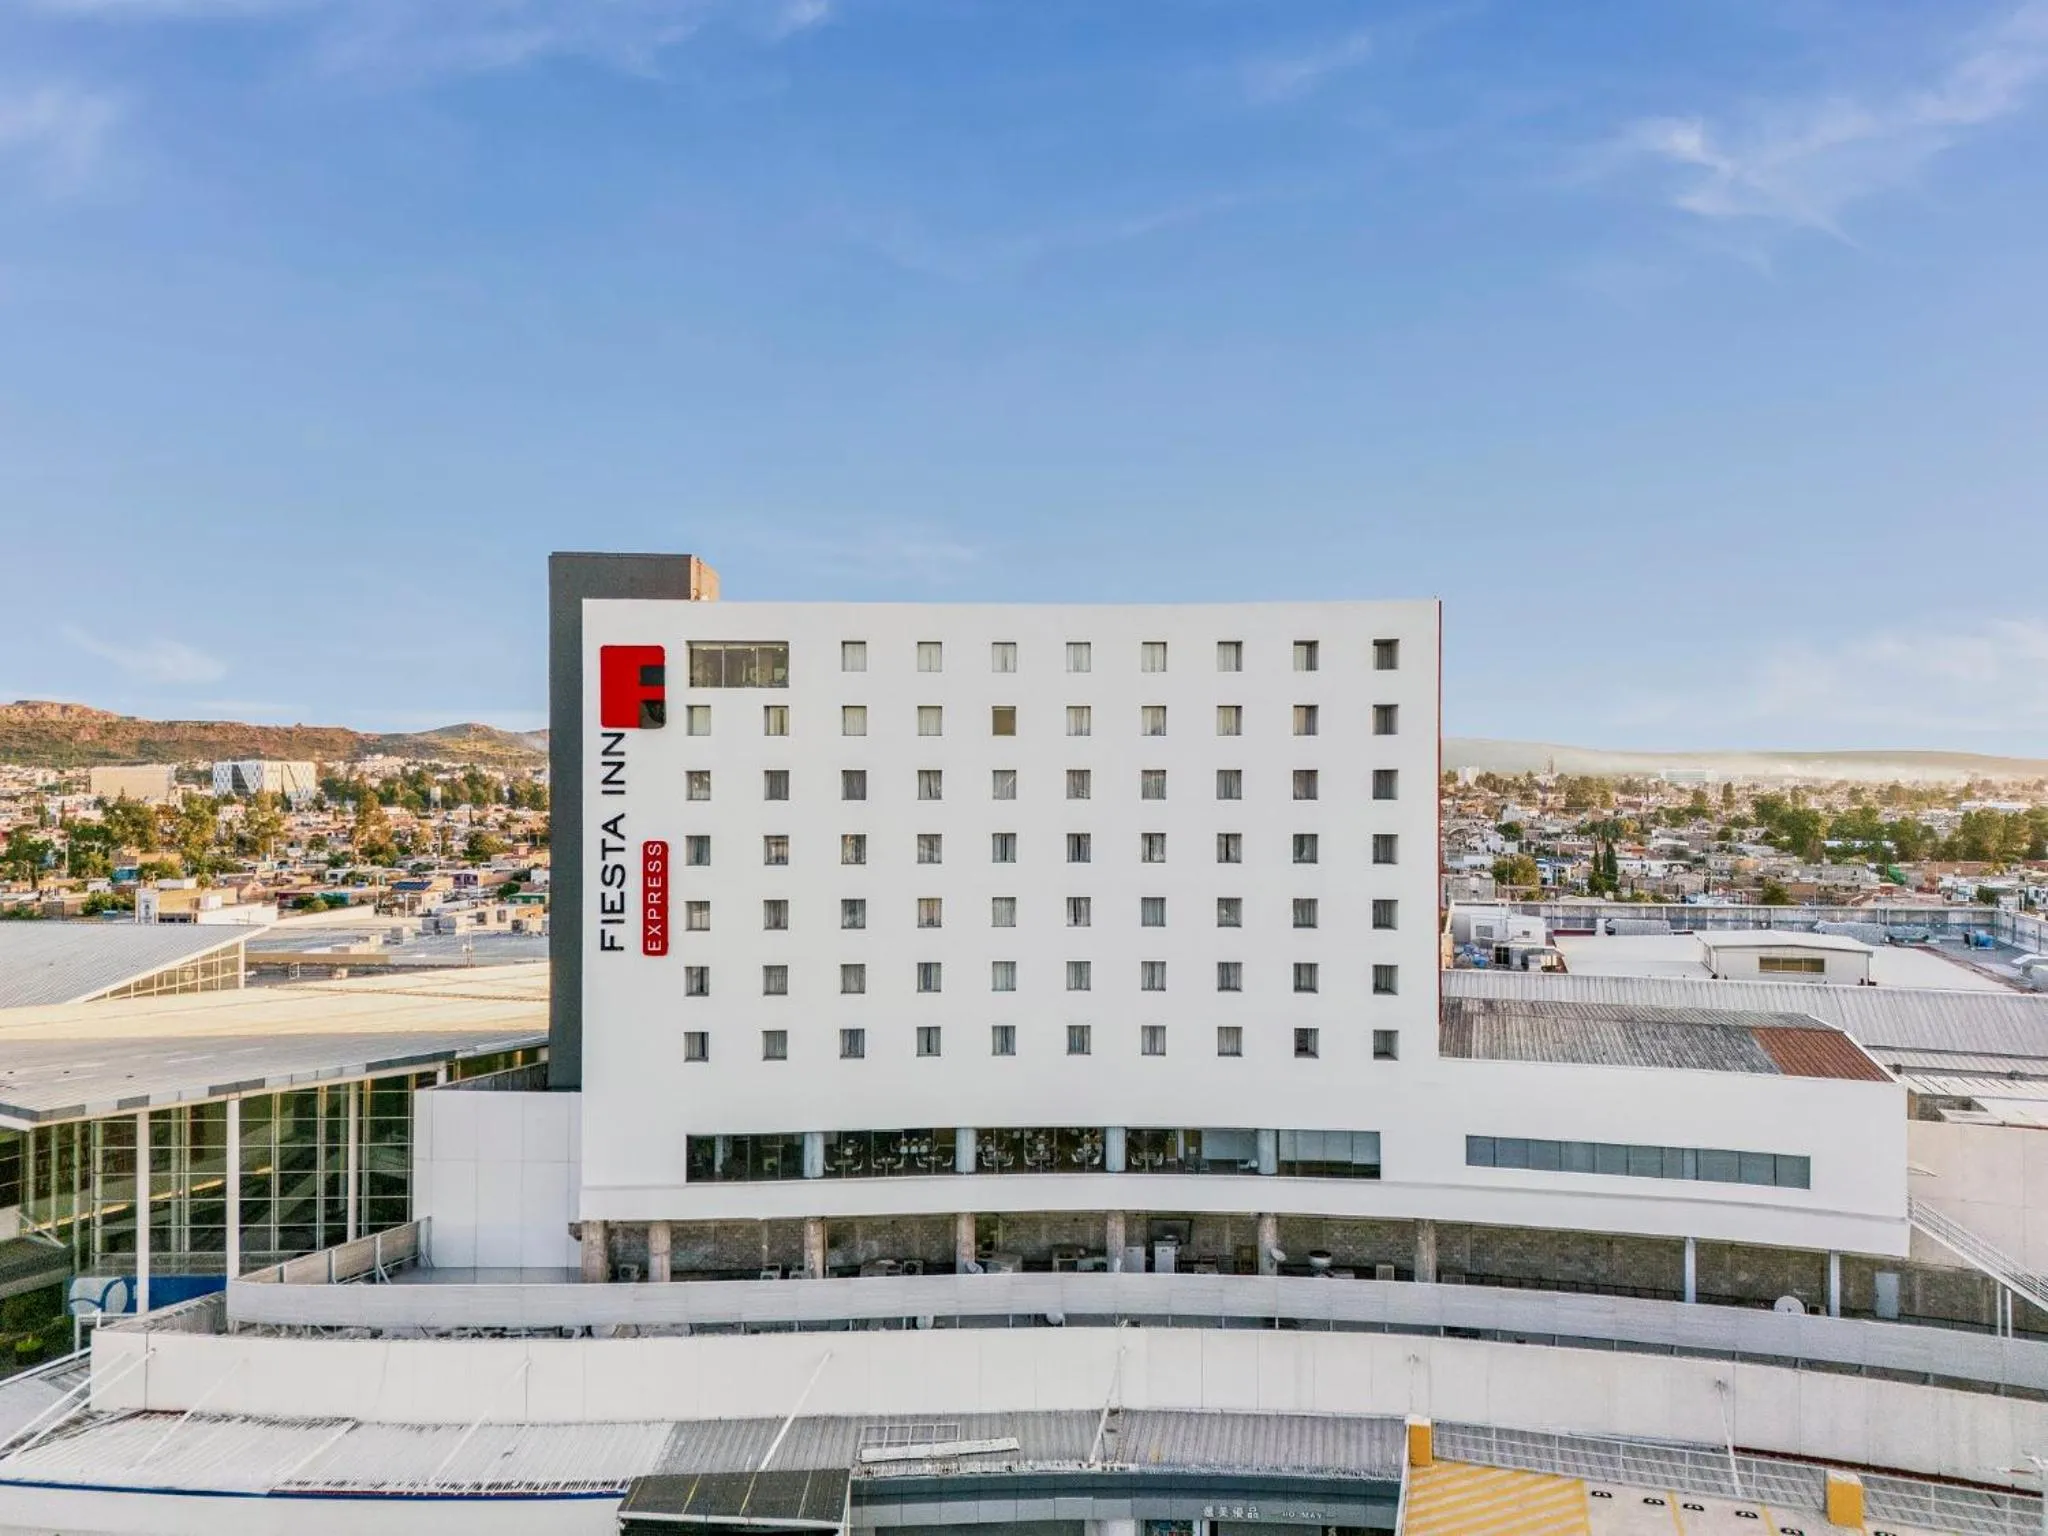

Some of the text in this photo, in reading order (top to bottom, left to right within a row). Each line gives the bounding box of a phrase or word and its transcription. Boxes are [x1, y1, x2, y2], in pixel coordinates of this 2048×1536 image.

[600, 732, 626, 952] FIESTA INN
[647, 843, 662, 952] EXPRESS
